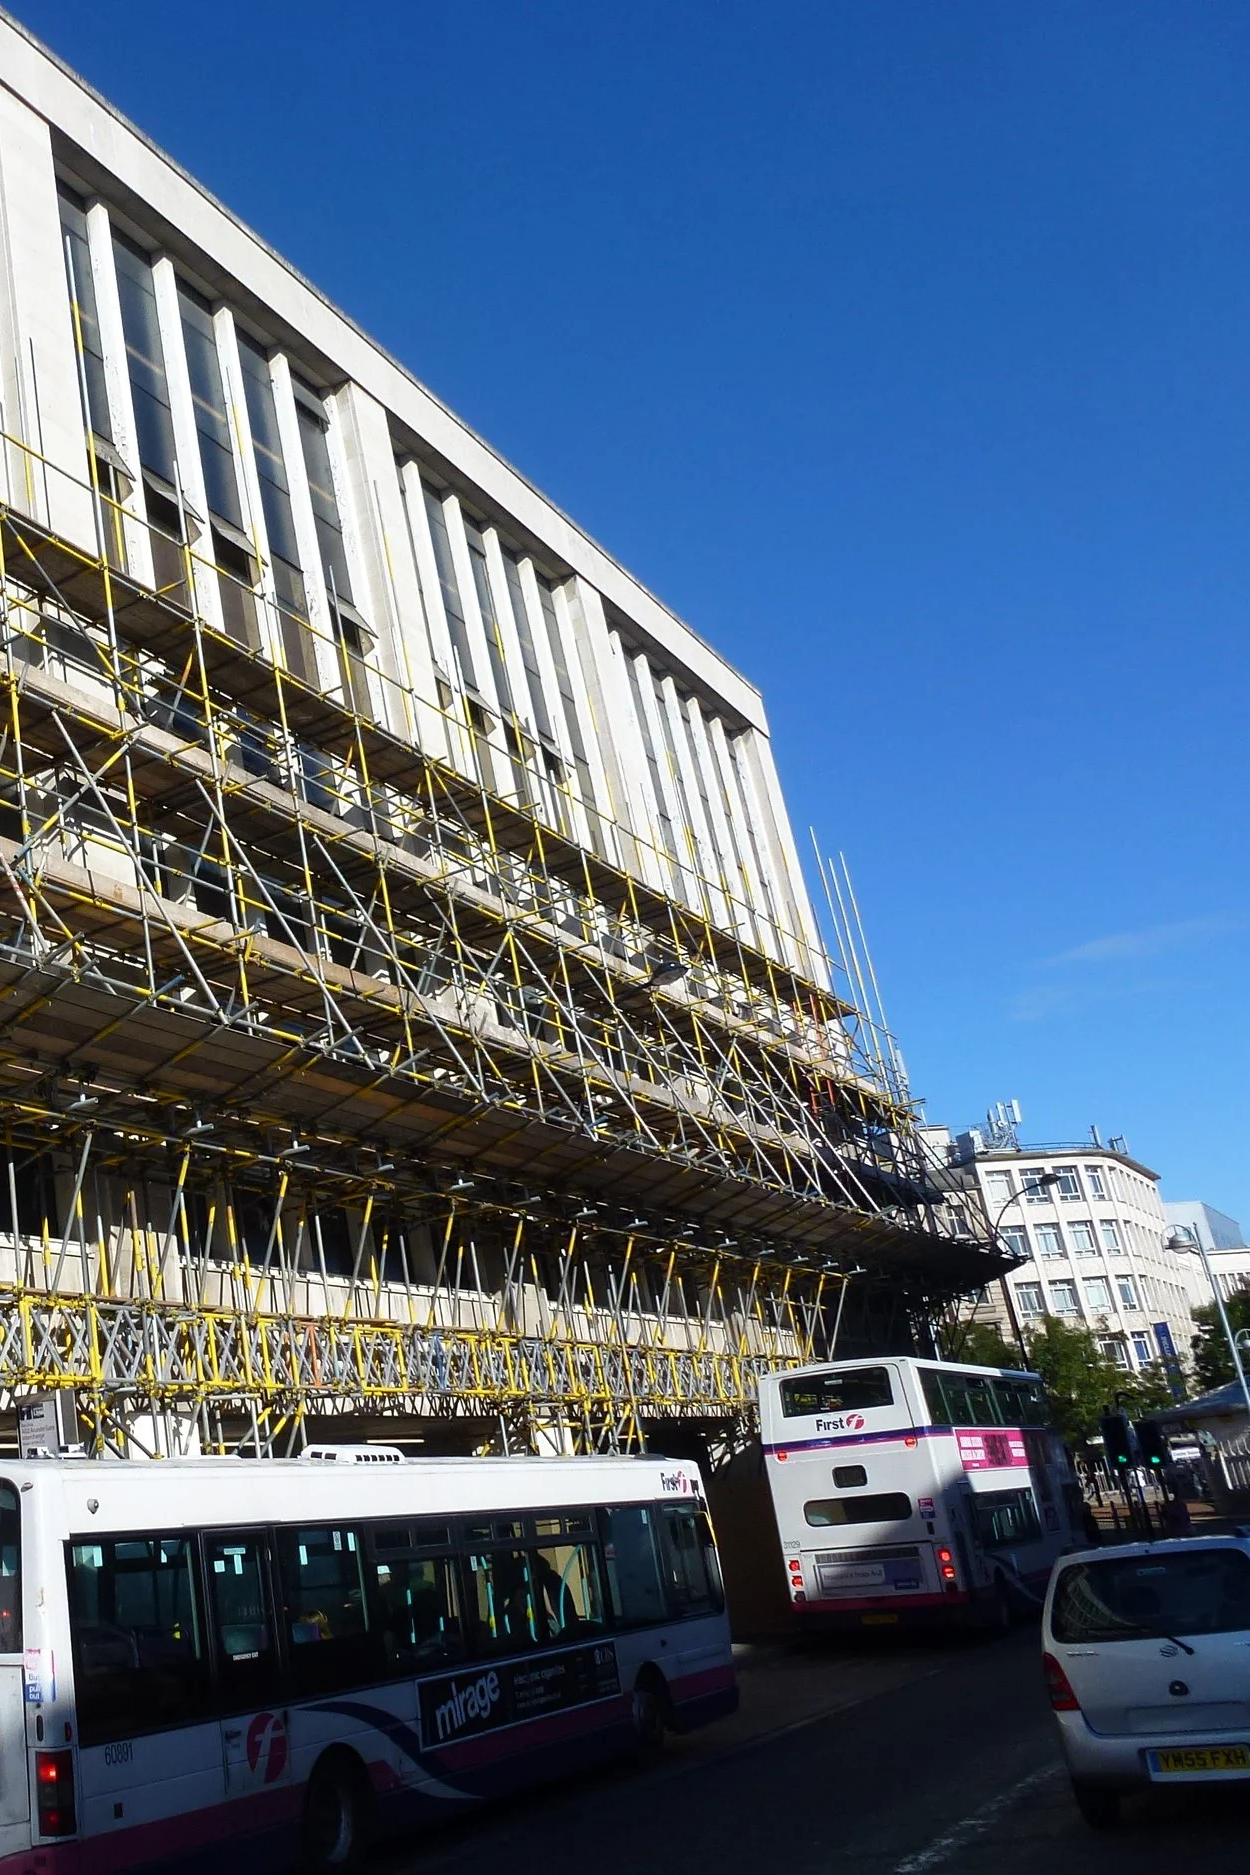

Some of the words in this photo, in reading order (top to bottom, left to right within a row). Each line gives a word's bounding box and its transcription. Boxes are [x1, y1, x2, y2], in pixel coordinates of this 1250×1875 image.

[815, 1417, 845, 1431] First
[660, 1472, 679, 1491] First
[434, 1670, 501, 1741] mirage
[105, 1742, 134, 1766] 60891
